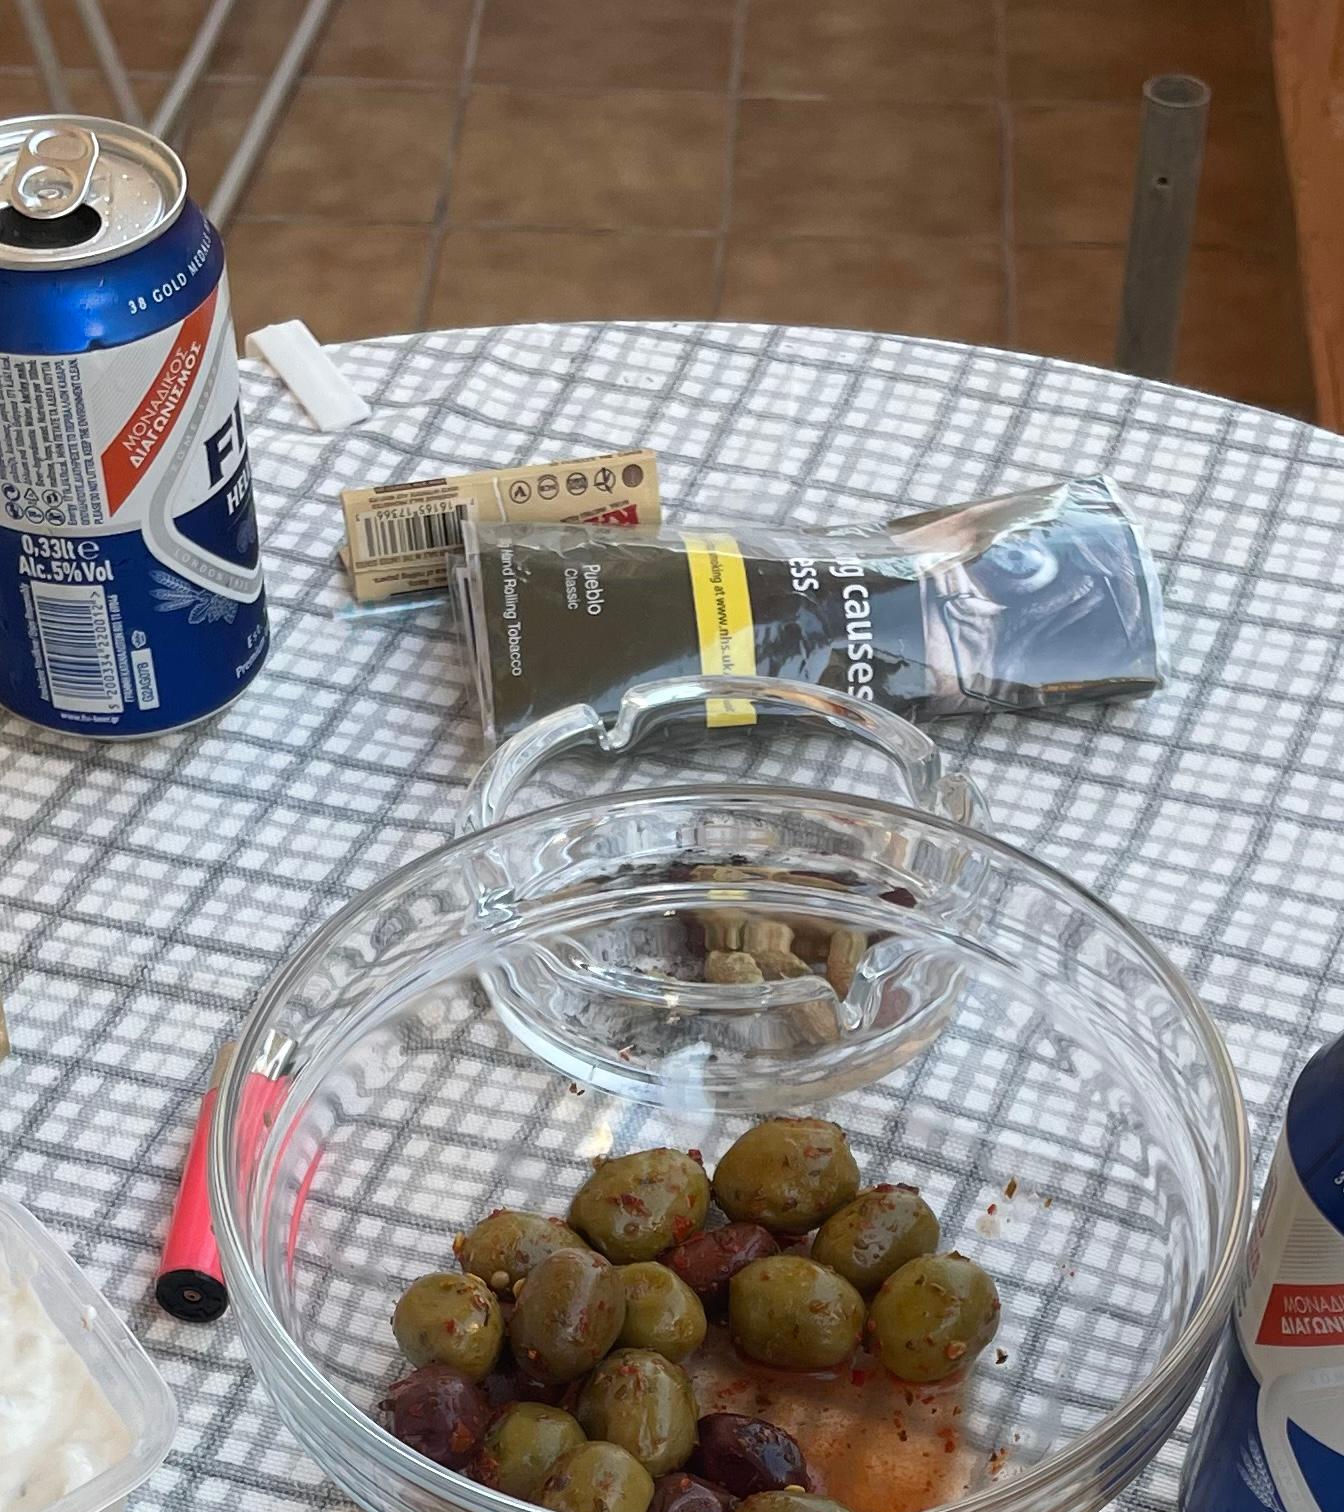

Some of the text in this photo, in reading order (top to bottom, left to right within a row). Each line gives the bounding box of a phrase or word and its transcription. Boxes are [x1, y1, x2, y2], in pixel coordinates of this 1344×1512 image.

[128, 231, 212, 315] 38 GOLD MEDALS
[122, 346, 188, 451] ΜΟΝΑΔΙΚΟΣ
[130, 340, 202, 469] ΔΙΑΓΩΝΙΣΜΟΣ
[21, 534, 76, 560] 0,33lt
[501, 548, 516, 576] Hand
[503, 579, 518, 620] Rolling
[564, 568, 581, 610] Classic
[582, 564, 605, 616] Pueblo
[713, 585, 726, 597] at
[91, 604, 110, 649] 220012
[507, 621, 522, 676] Tobacco
[842, 584, 874, 701] causes
